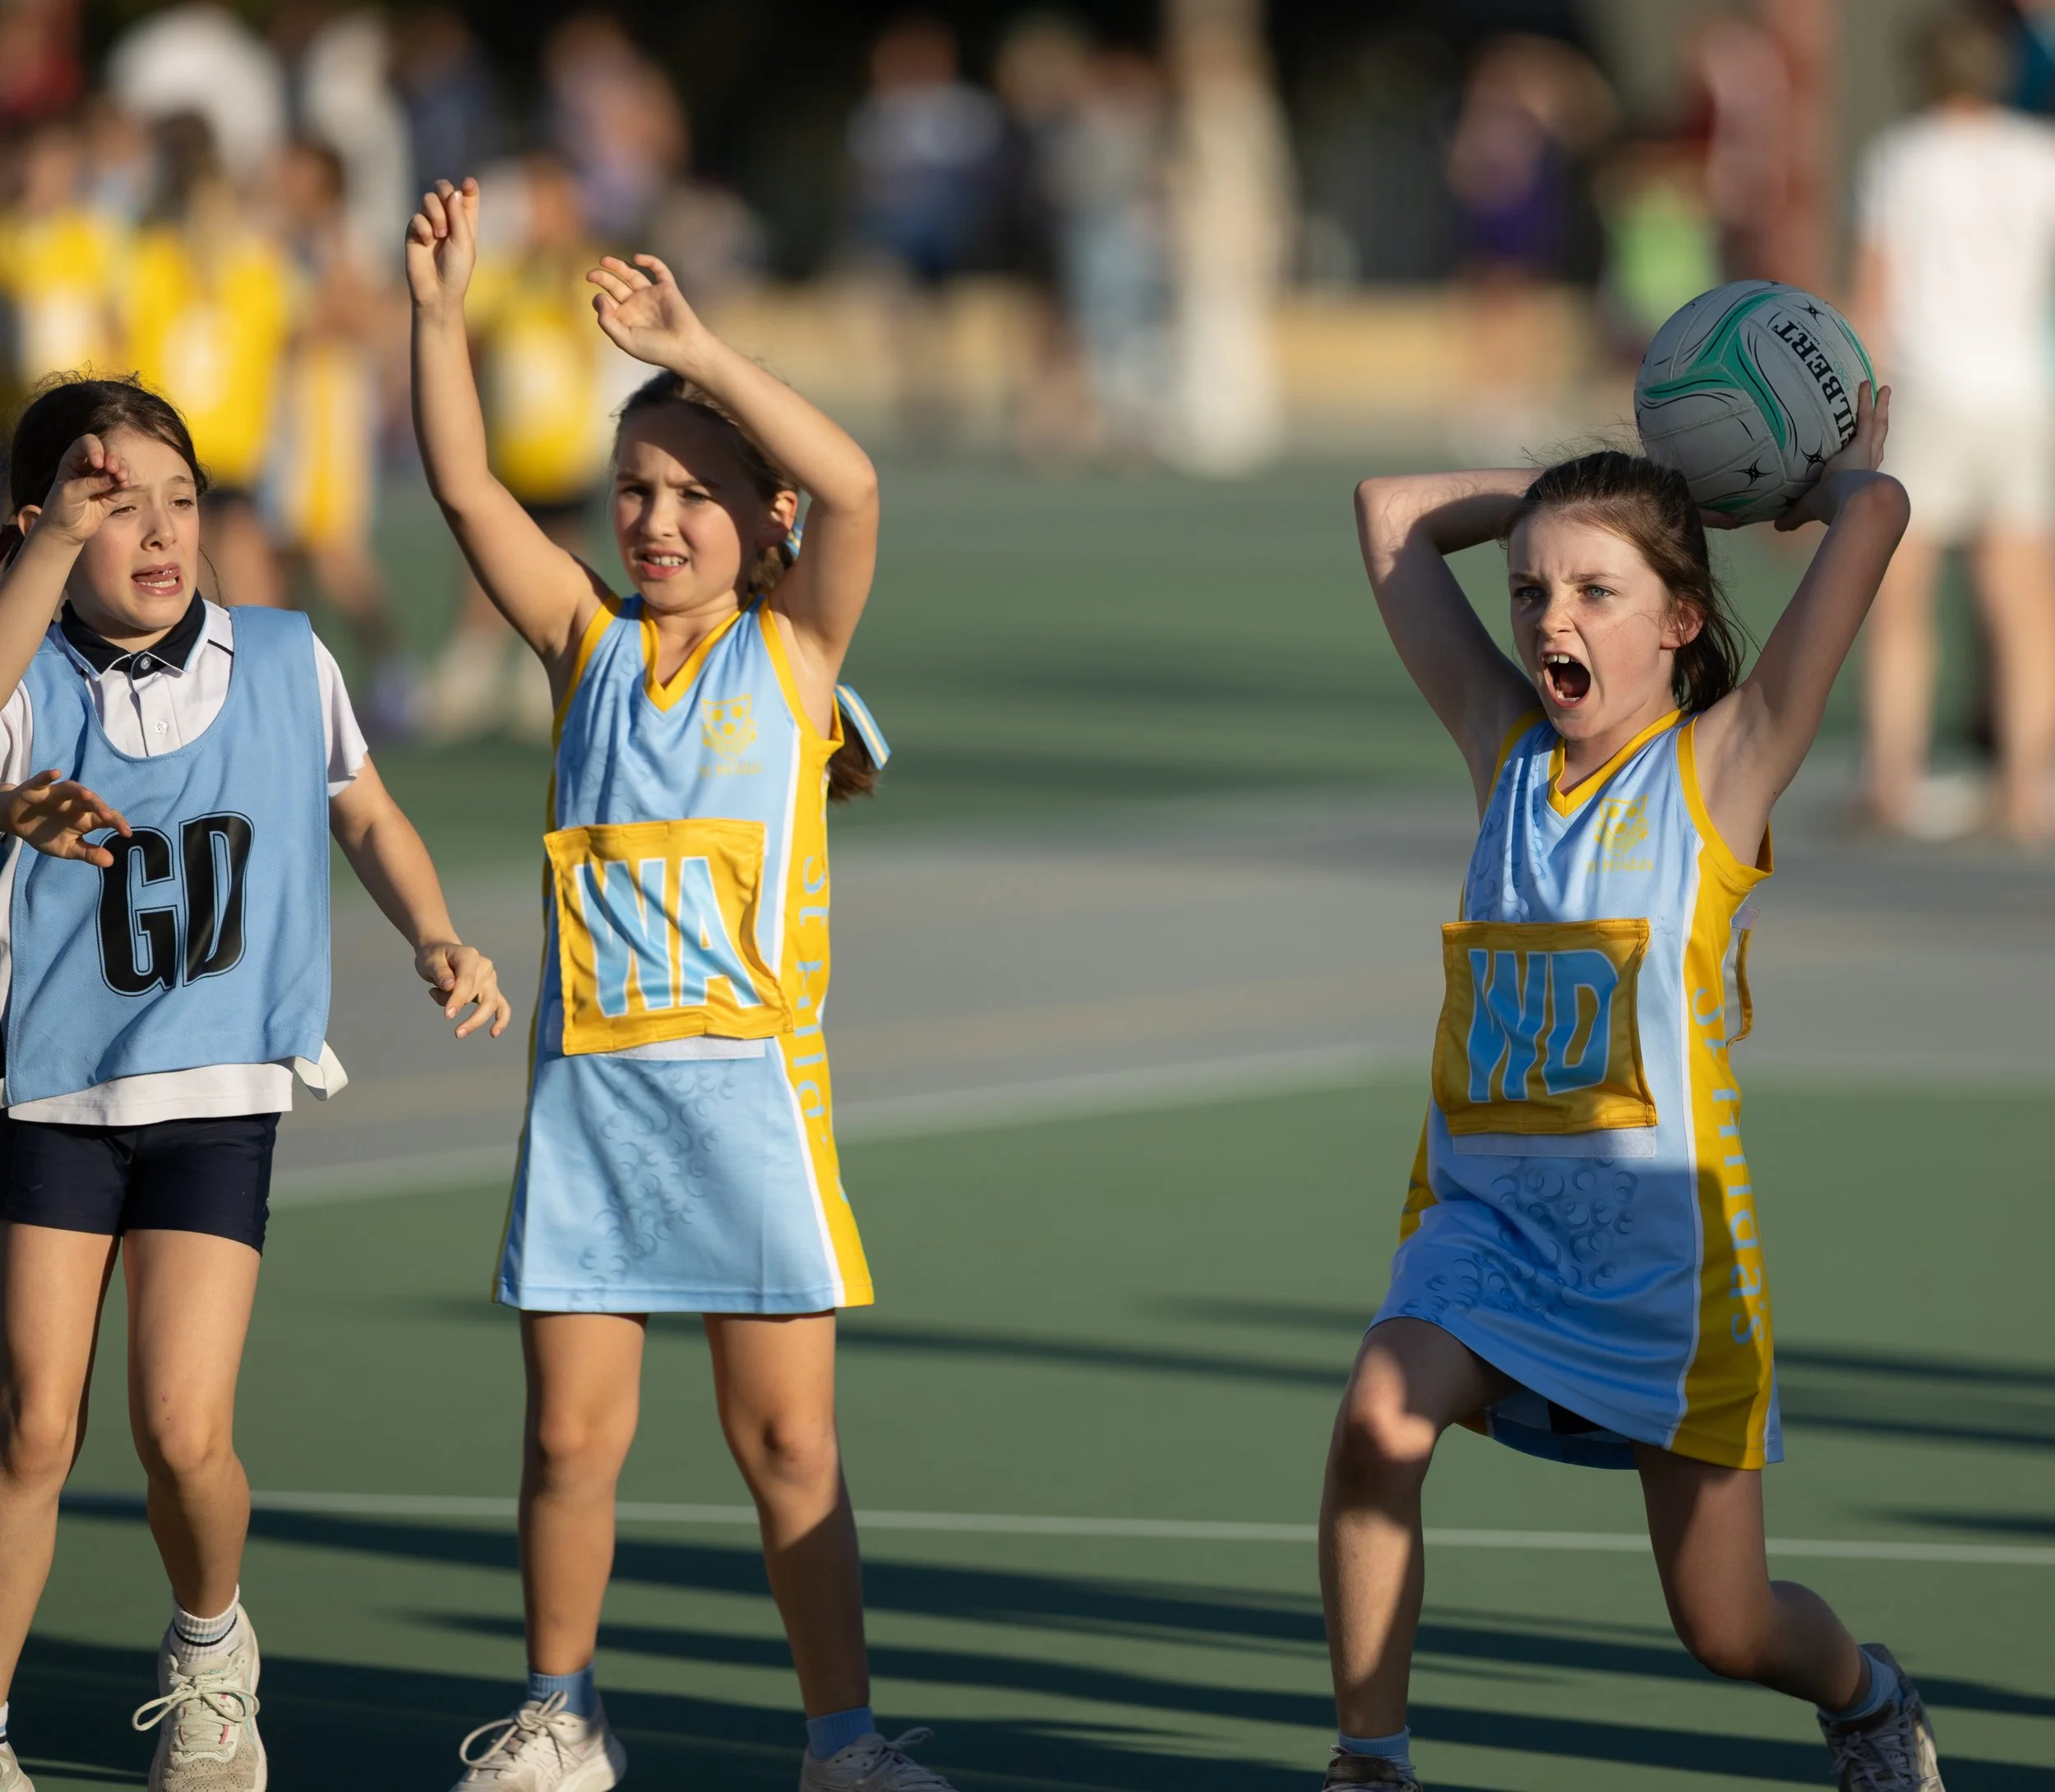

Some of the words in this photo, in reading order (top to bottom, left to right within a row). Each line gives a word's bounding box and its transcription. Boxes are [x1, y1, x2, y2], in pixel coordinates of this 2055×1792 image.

[96, 811, 255, 997] GD
[573, 856, 764, 1018] WA
[1466, 948, 1619, 1103] WD
